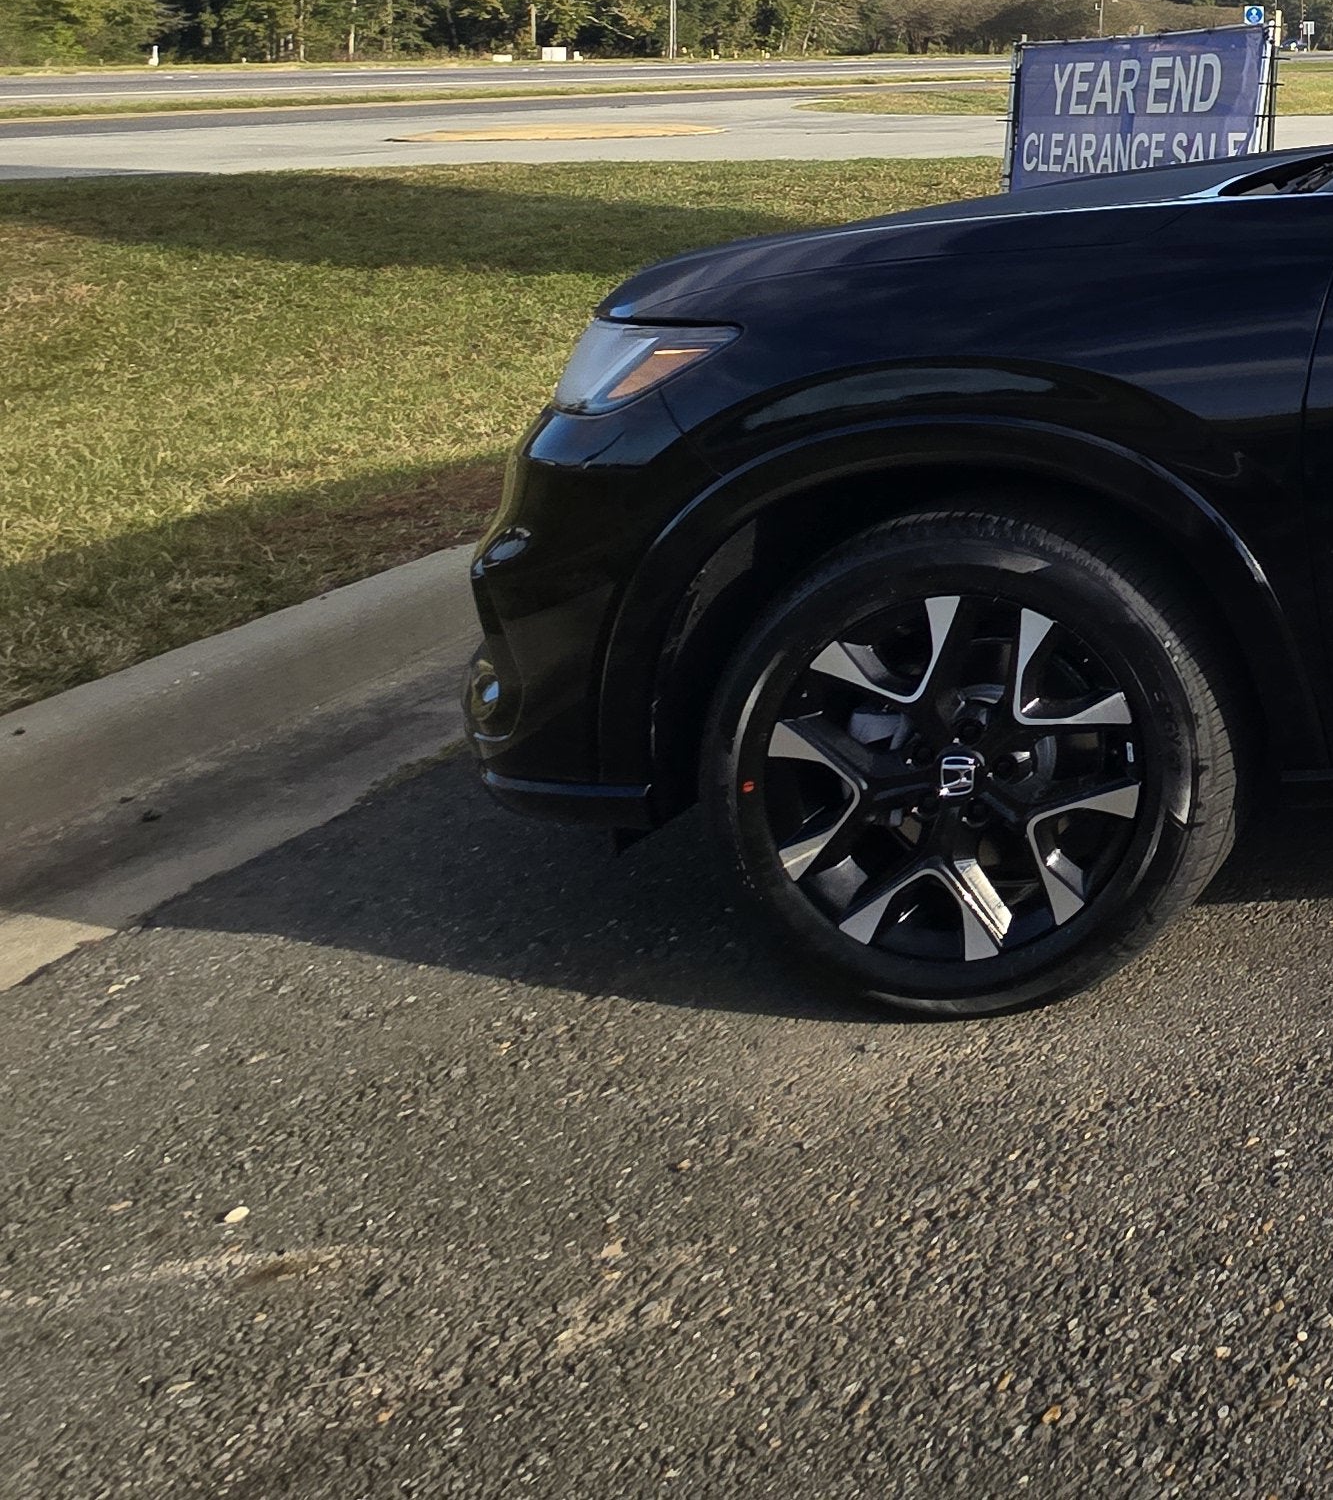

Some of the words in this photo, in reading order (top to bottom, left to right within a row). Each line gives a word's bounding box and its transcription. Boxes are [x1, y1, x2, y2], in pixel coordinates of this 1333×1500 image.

[1053, 61, 1140, 116] YEAR
[1146, 53, 1223, 114] END
[1022, 131, 1166, 174] CLEARANCE
